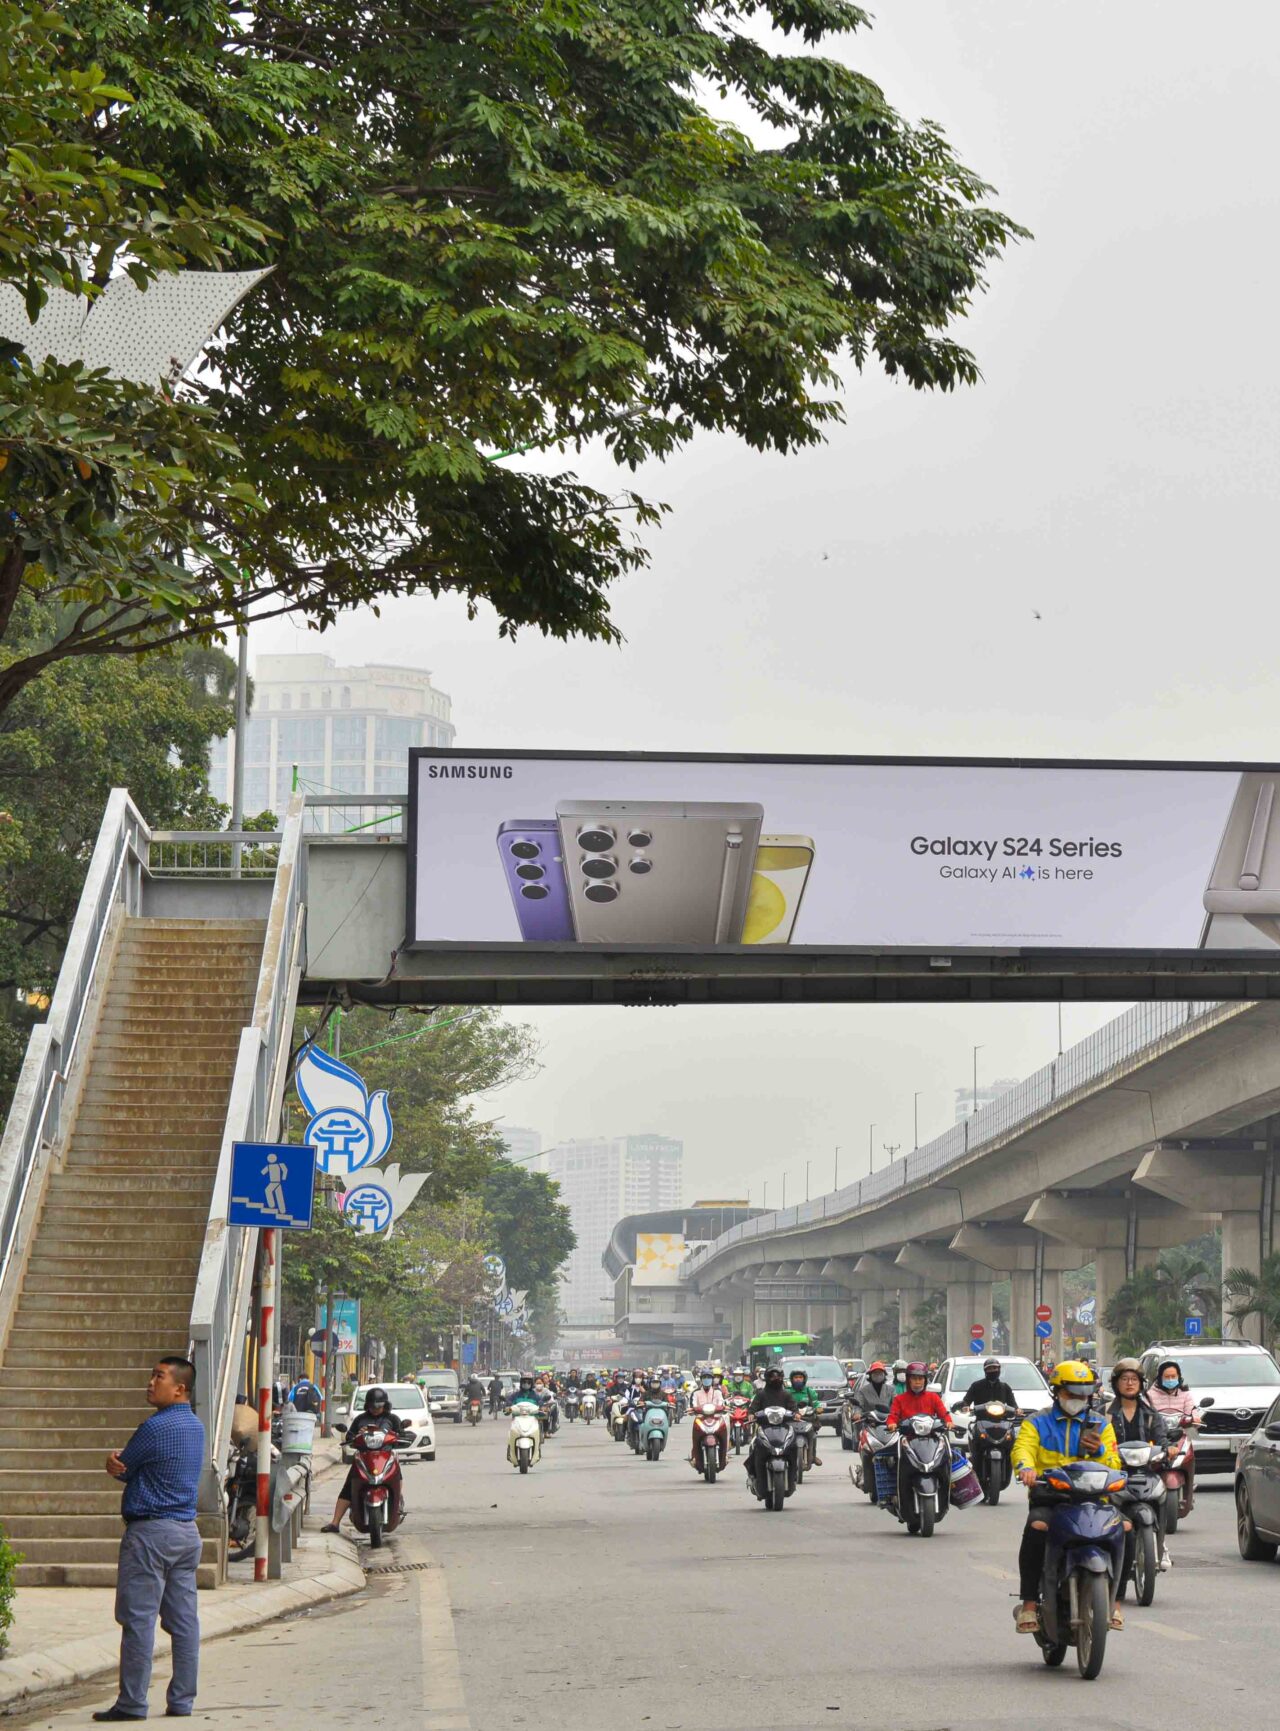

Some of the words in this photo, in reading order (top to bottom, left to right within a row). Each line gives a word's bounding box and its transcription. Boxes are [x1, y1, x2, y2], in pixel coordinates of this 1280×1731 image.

[428, 765, 513, 779] SAMSUNG
[910, 836, 998, 861] Galaxy
[1002, 837, 1043, 857] S24
[1049, 837, 1123, 858] Series
[939, 865, 998, 882] Galaxy
[1002, 866, 1016, 879] AI
[1038, 866, 1050, 880] is
[1055, 867, 1094, 880] here
